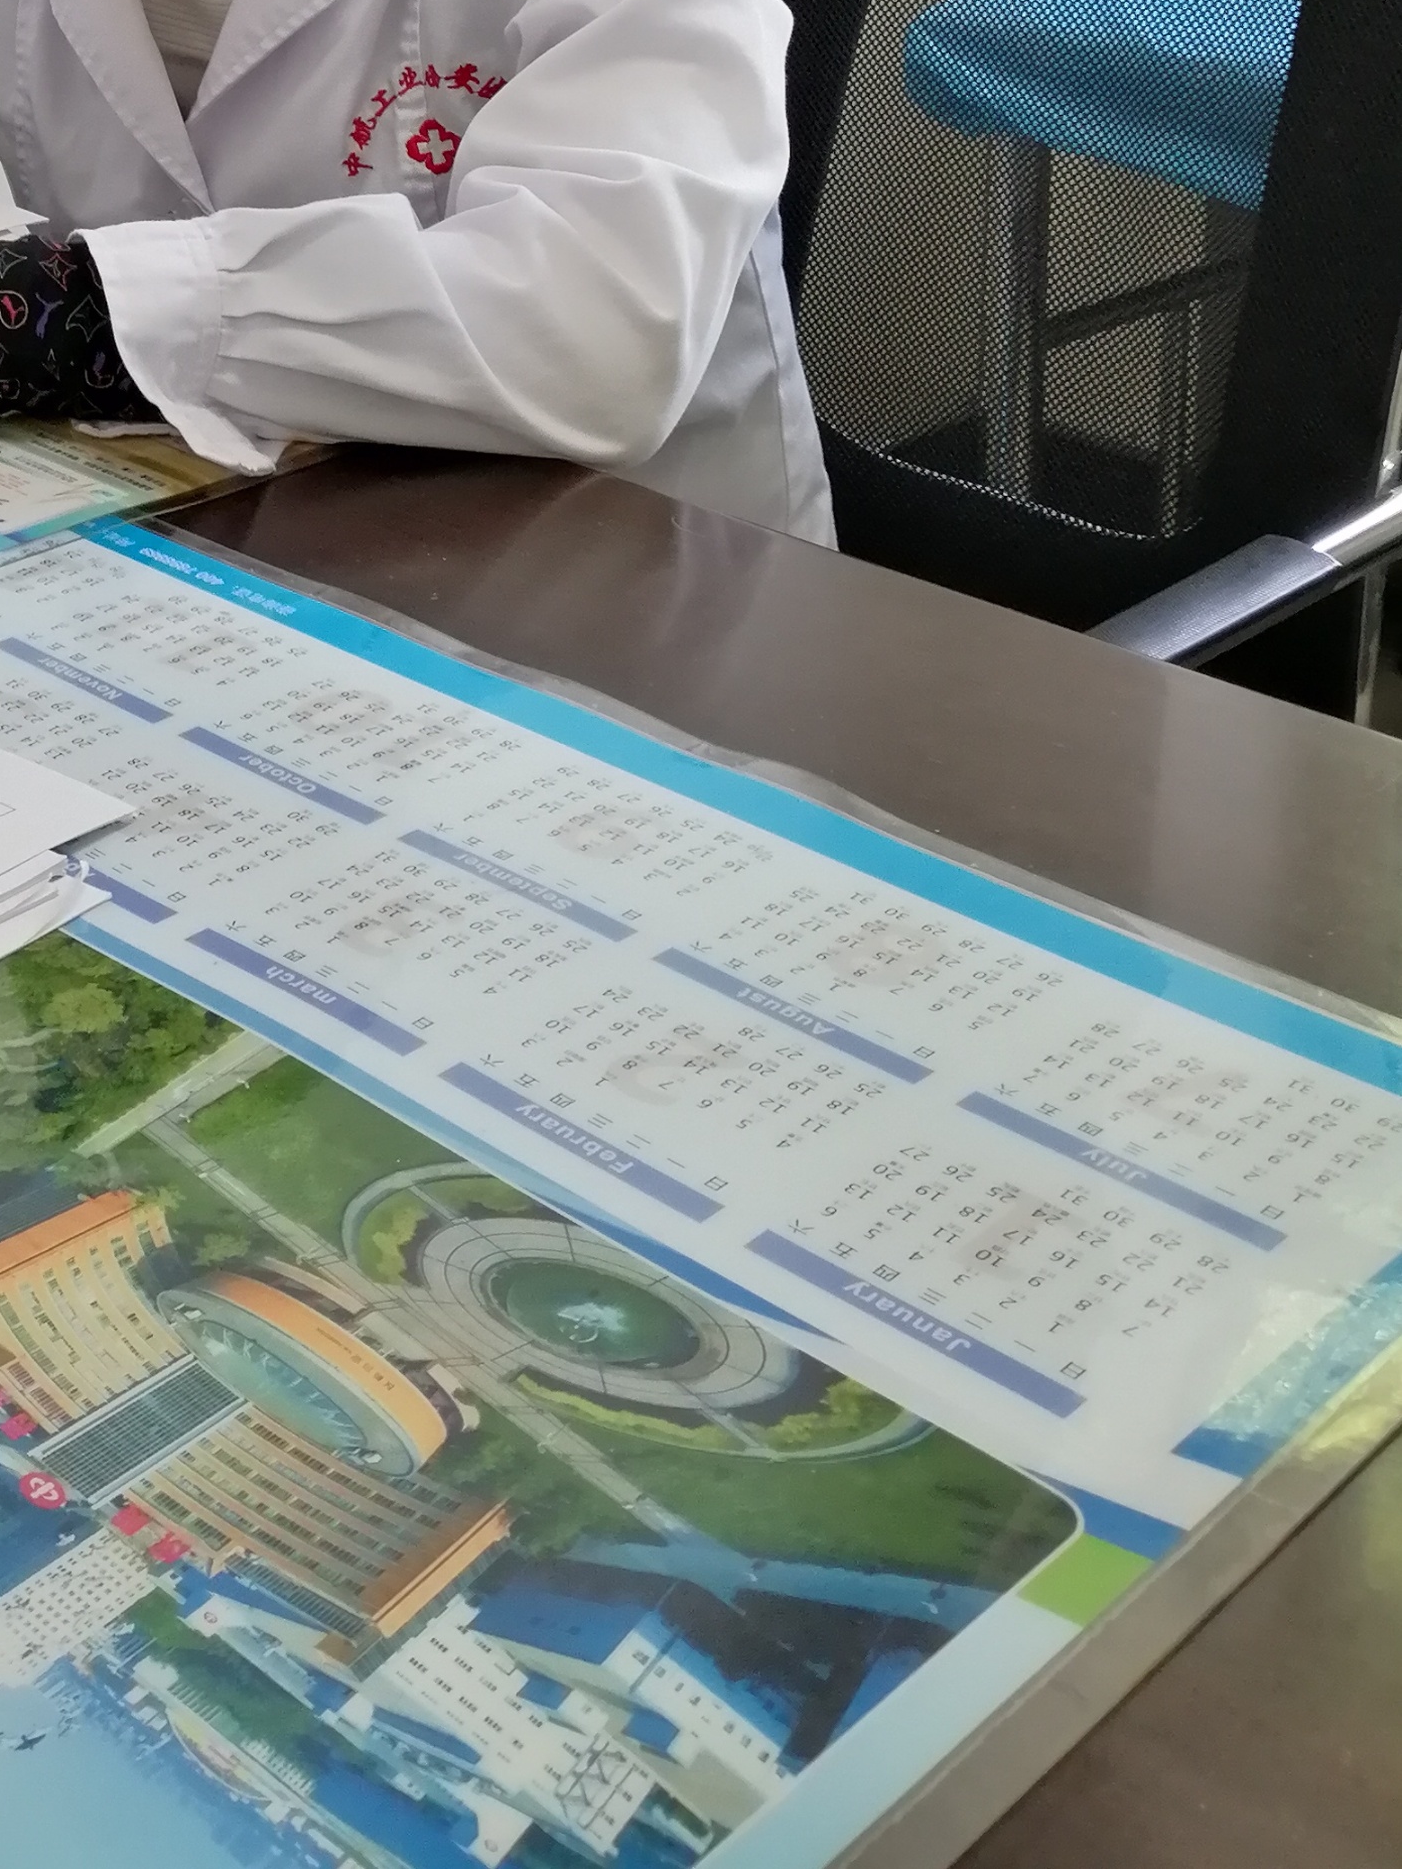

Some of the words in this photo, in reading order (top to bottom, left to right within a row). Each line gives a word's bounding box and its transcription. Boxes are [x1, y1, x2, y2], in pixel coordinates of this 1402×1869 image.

[38, 657, 124, 701] November
[239, 752, 317, 796] October
[374, 851, 396, 863] 31
[345, 864, 370, 877] 24
[402, 865, 421, 877] 30
[317, 878, 339, 890] 17
[375, 878, 399, 890] 23
[433, 879, 458, 891] 29
[453, 852, 574, 911] September
[350, 891, 370, 904] 16
[405, 891, 431, 904] 22
[464, 892, 490, 906] 28
[378, 905, 402, 918] 15
[438, 906, 462, 919] 21
[495, 909, 522, 920] 27
[409, 920, 434, 933] 14
[469, 921, 495, 935] 20
[529, 923, 555, 937] 26
[440, 935, 466, 948] 13
[501, 937, 525, 950] 19
[562, 939, 588, 953] 25
[472, 951, 498, 965] 12
[534, 953, 560, 968] 18
[508, 968, 532, 983] 11
[601, 988, 629, 1003] 24
[572, 1005, 600, 1019] 17
[636, 1006, 665, 1022] 23
[737, 988, 836, 1036] August
[545, 1019, 572, 1034] 10
[608, 1022, 635, 1037] 16
[672, 1024, 700, 1040] 22
[737, 1026, 766, 1042] 28
[520, 1038, 537, 1048] 3
[585, 1041, 602, 1051] 9
[645, 1040, 671, 1056] 15
[712, 1043, 738, 1058] 21
[479, 1053, 505, 1068] 六
[774, 1046, 804, 1061] 27
[556, 1057, 574, 1067] 2
[621, 1059, 638, 1070] 8
[683, 1059, 708, 1076] 14
[748, 1061, 777, 1077] 20
[513, 1072, 540, 1088] 五
[814, 1064, 843, 1080] 26
[594, 1076, 609, 1087] 1
[657, 1081, 675, 1091] 7
[720, 1078, 748, 1094] 13
[786, 1081, 815, 1096] 19
[853, 1082, 883, 1098] 25
[549, 1092, 577, 1109] 四
[698, 1099, 713, 1109] 6
[758, 1097, 787, 1113] 12
[826, 1099, 853, 1116] 18
[587, 1112, 614, 1129] 三
[735, 1118, 752, 1130] 5
[800, 1117, 827, 1133] 11
[515, 1103, 635, 1176] February
[625, 1133, 652, 1150] 二
[776, 1139, 791, 1148] 4
[898, 1146, 930, 1162] 27
[872, 1163, 903, 1181] 20
[1082, 1147, 1148, 1183] July
[942, 1165, 973, 1183] 26
[703, 1175, 729, 1192] 日
[844, 1183, 873, 1200] 13
[915, 1185, 945, 1202] 19
[986, 1186, 1017, 1203] 25
[1059, 1188, 1085, 1206] 31
[822, 1206, 838, 1217] 6
[886, 1204, 916, 1222] 12
[958, 1205, 989, 1224] 18
[1031, 1207, 1063, 1225] 24
[1102, 1210, 1128, 1228] 30
[787, 1218, 815, 1236] 六
[863, 1228, 882, 1240] 5
[932, 1226, 959, 1244] 11
[1002, 1230, 1031, 1246] 17
[1076, 1230, 1108, 1247] 23
[1149, 1232, 1182, 1249] 29
[829, 1241, 858, 1260] 五
[908, 1251, 924, 1261] 4
[974, 1249, 1004, 1268] 10
[1049, 1250, 1079, 1268] 16
[1122, 1252, 1155, 1272] 22
[1196, 1255, 1230, 1273] 28
[872, 1263, 901, 1282] 四
[952, 1274, 970, 1286] 3
[1027, 1276, 1045, 1288] 9
[1095, 1273, 1127, 1292] 15
[1172, 1275, 1203, 1295] 21
[918, 1287, 947, 1306] 三
[998, 1296, 1018, 1310] 2
[1074, 1299, 1093, 1311] 8
[1143, 1297, 1173, 1318] 14
[843, 1280, 973, 1353] January
[964, 1311, 993, 1331] 二
[1048, 1321, 1062, 1333] 1
[1121, 1326, 1139, 1338] 7
[1059, 1361, 1087, 1380] 日
